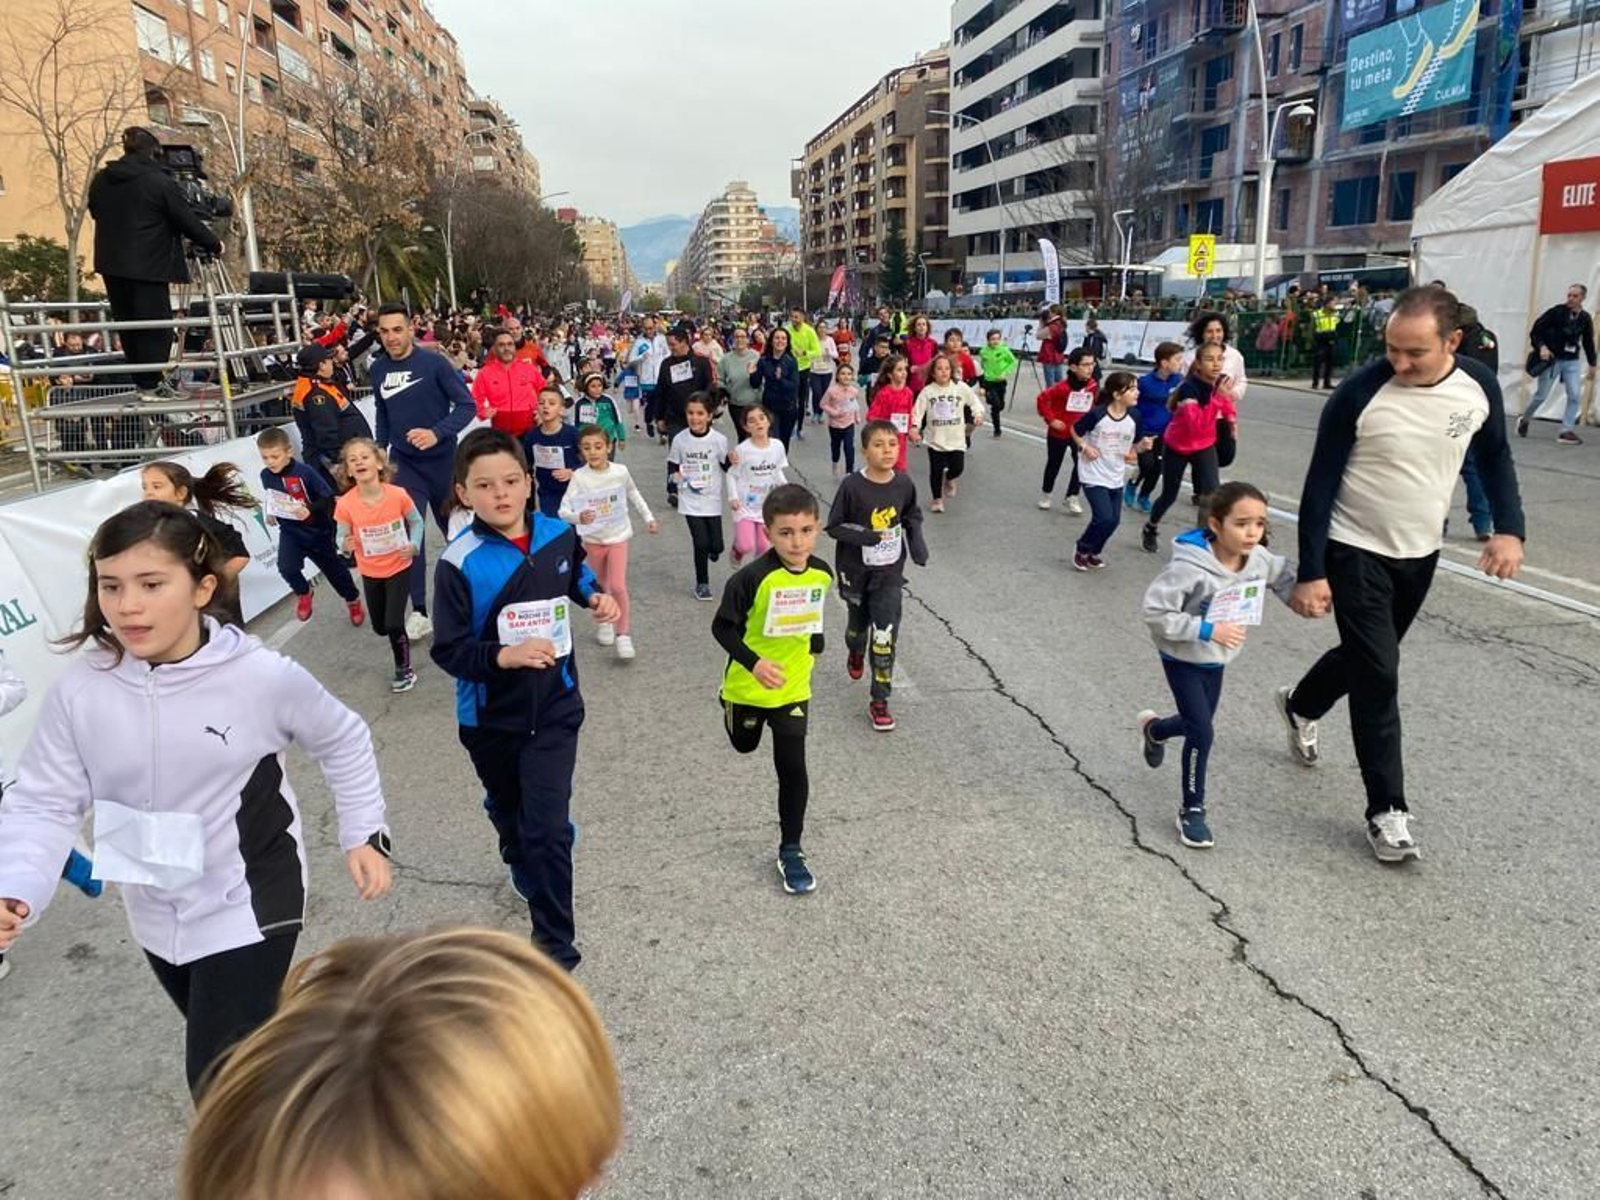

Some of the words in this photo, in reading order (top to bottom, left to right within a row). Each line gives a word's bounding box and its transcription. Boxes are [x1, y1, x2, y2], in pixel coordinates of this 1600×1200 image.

[1351, 49, 1395, 73] Destino,
[1351, 77, 1361, 91] tu
[1365, 68, 1392, 86] meta
[1562, 182, 1597, 207] ELITE
[384, 371, 412, 387] NIKE
[0, 598, 37, 632] AL
